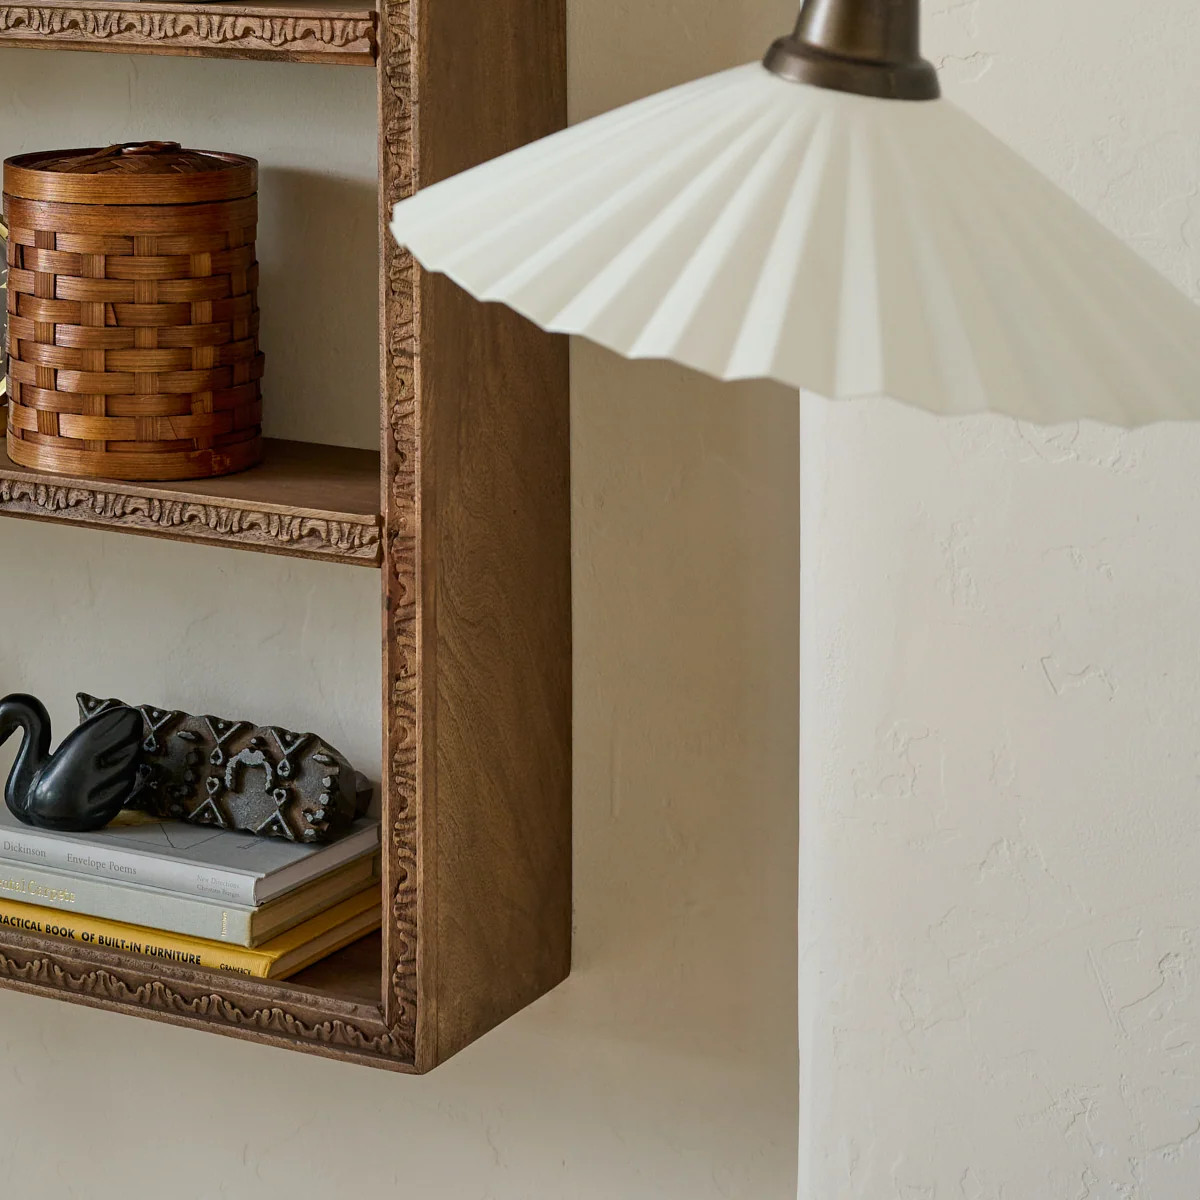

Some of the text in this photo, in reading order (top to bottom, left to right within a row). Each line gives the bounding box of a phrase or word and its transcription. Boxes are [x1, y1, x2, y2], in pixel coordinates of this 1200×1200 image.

[4, 840, 46, 858] Dickinson
[66, 853, 137, 875] Envelope Poems
[27, 880, 76, 903] Carpets
[45, 924, 75, 940] BOOK
[81, 932, 96, 943] OF
[98, 934, 142, 953] BUILT-IN
[145, 944, 201, 966] FURNITURE
